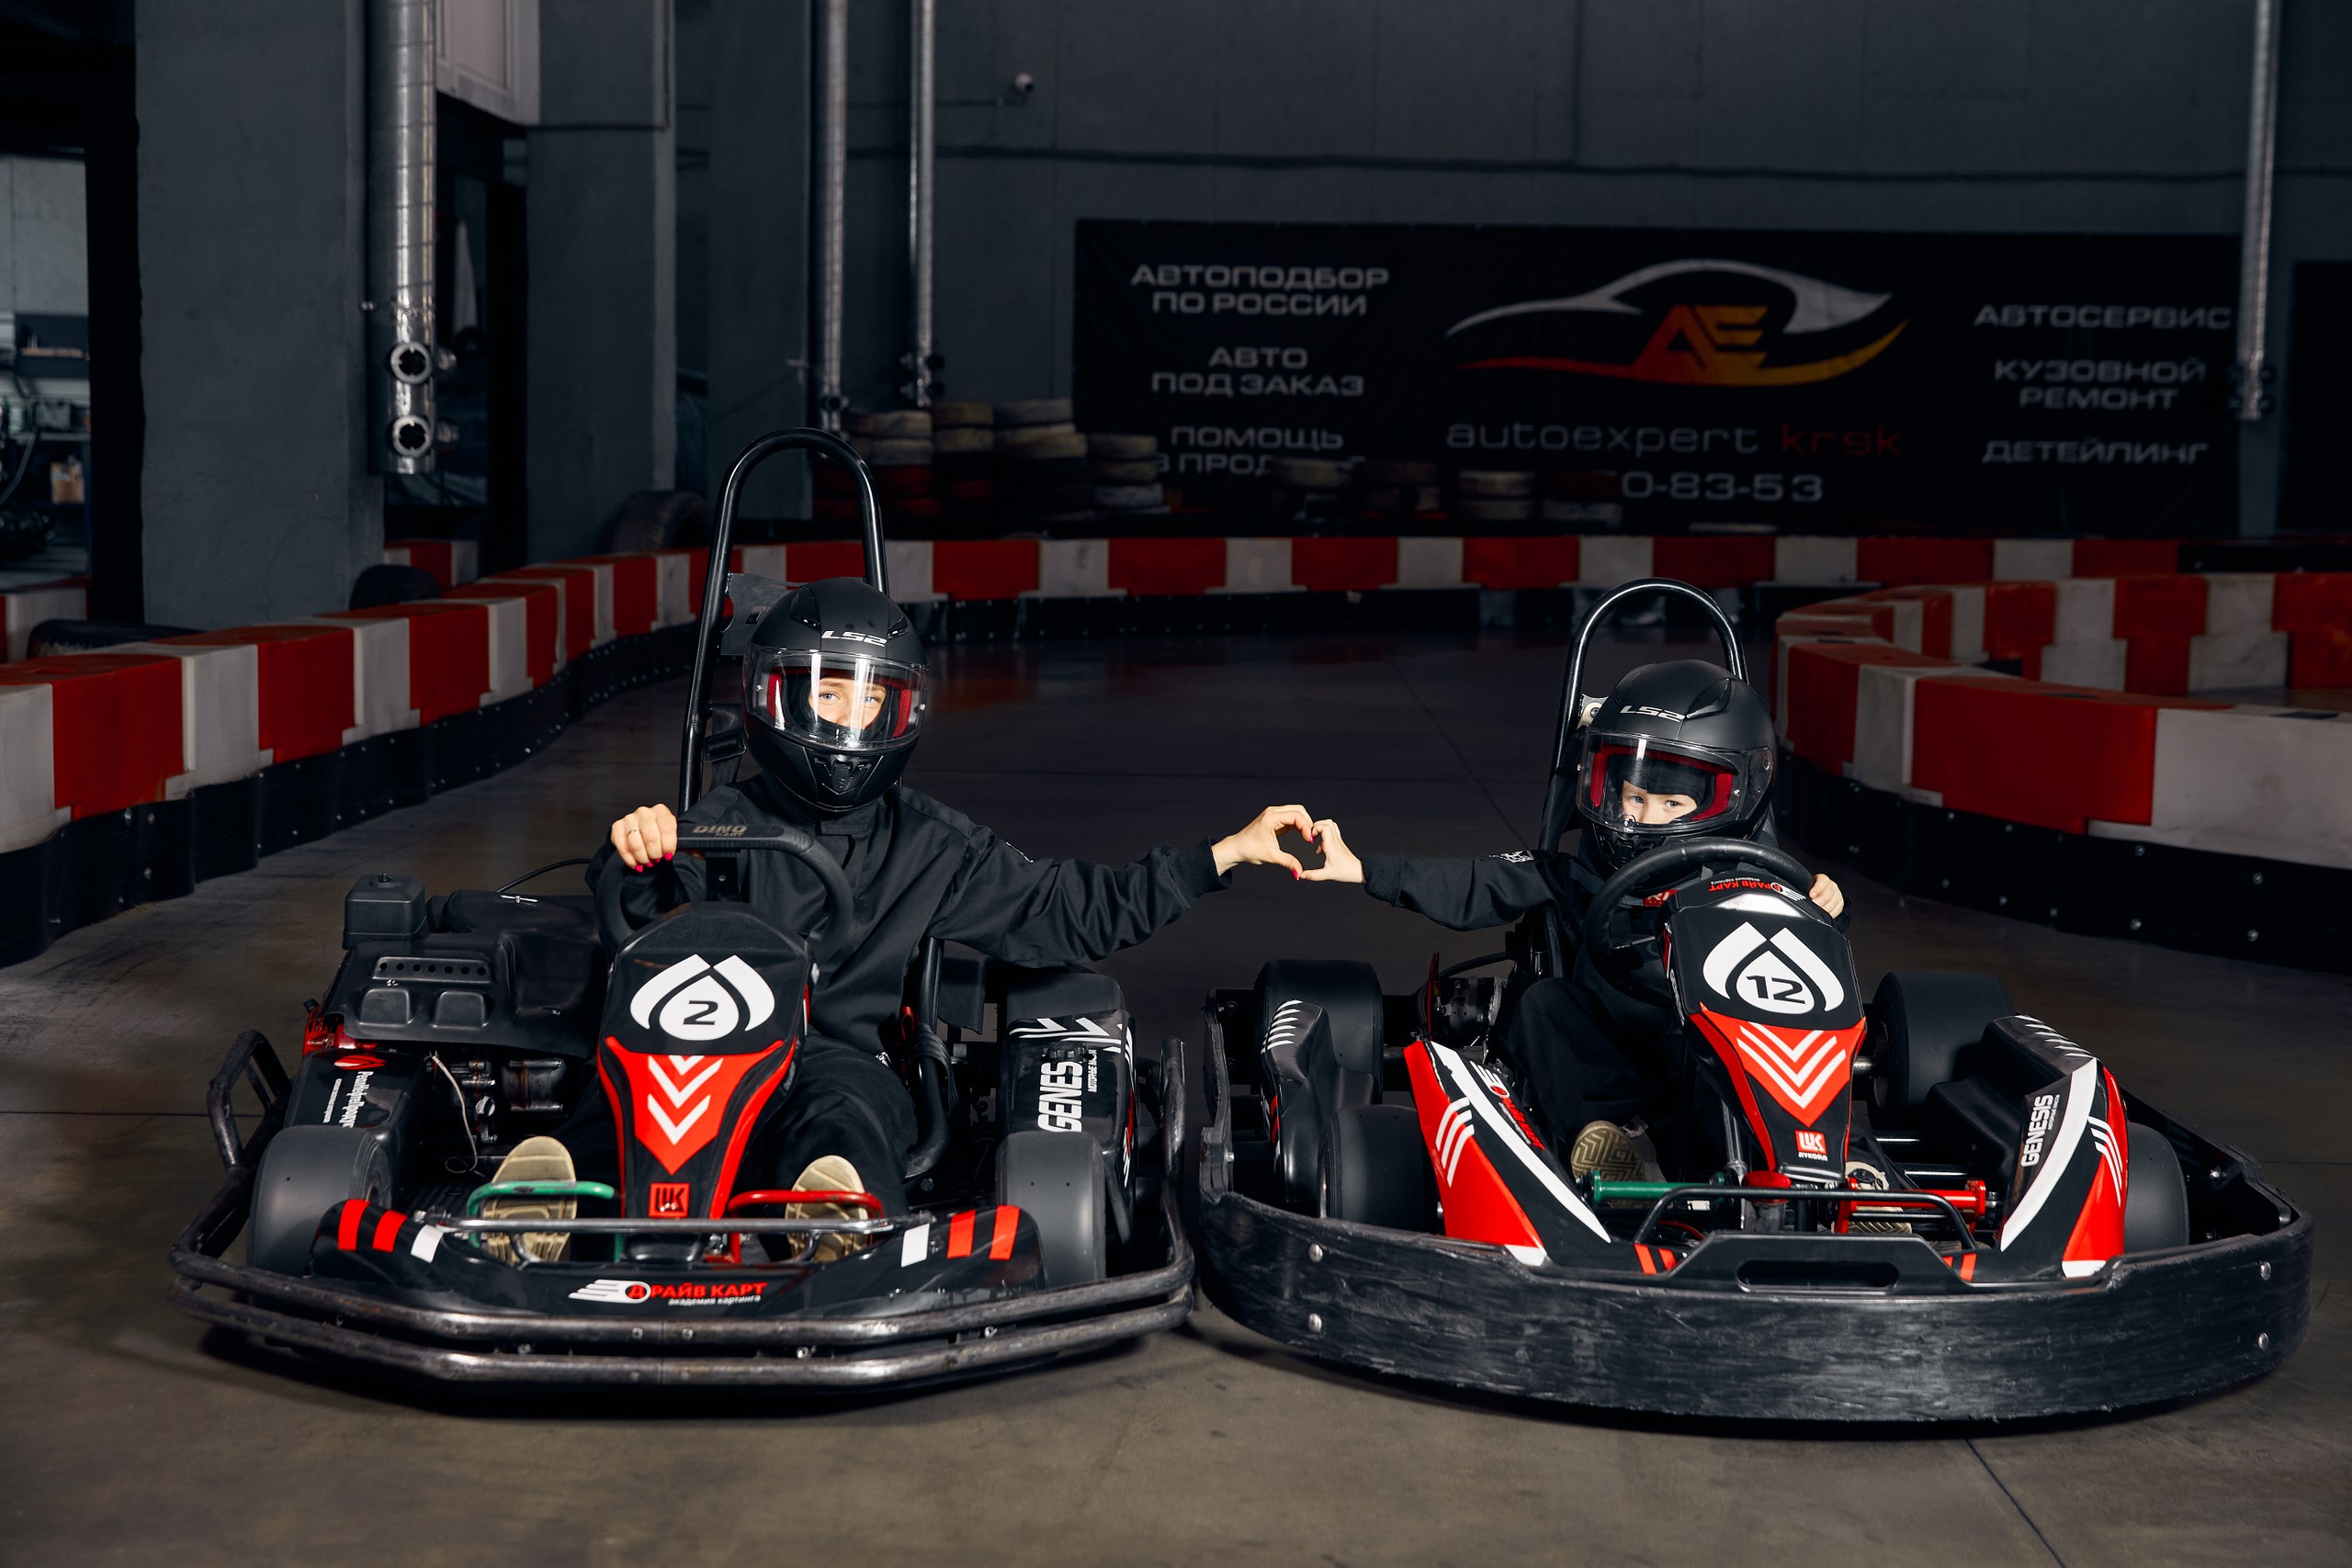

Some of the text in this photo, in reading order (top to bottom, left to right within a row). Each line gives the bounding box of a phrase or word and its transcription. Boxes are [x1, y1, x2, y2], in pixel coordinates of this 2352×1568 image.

[1130, 263, 1390, 292] АВТОПОДБОР
[1151, 290, 1368, 317] ПО РОССИИ
[1973, 303, 2233, 331] АВТОСЕРВИС
[1206, 344, 1309, 369] АВТО
[1993, 355, 2208, 385] КУЗОВНОЙ
[1150, 371, 1366, 399] ПОД ЗАКАЗ
[2018, 385, 2181, 412] РЕМОНТ
[1170, 424, 1345, 453] ПОМОЩЬ
[1445, 420, 1904, 458] autoexpert krsk
[1981, 435, 2211, 466] ДЕТЕЙЛИНГ
[820, 630, 888, 648] LS2
[1619, 705, 1686, 723] LS2
[692, 825, 748, 834] DINO
[1745, 975, 1806, 1005] 12
[683, 999, 718, 1026] 2
[1036, 1060, 1083, 1133] GENES
[2021, 1095, 2053, 1167] GENESIS
[628, 1281, 768, 1300] ДРАЙВ КАРТ
[667, 1294, 762, 1306] академия картинга
